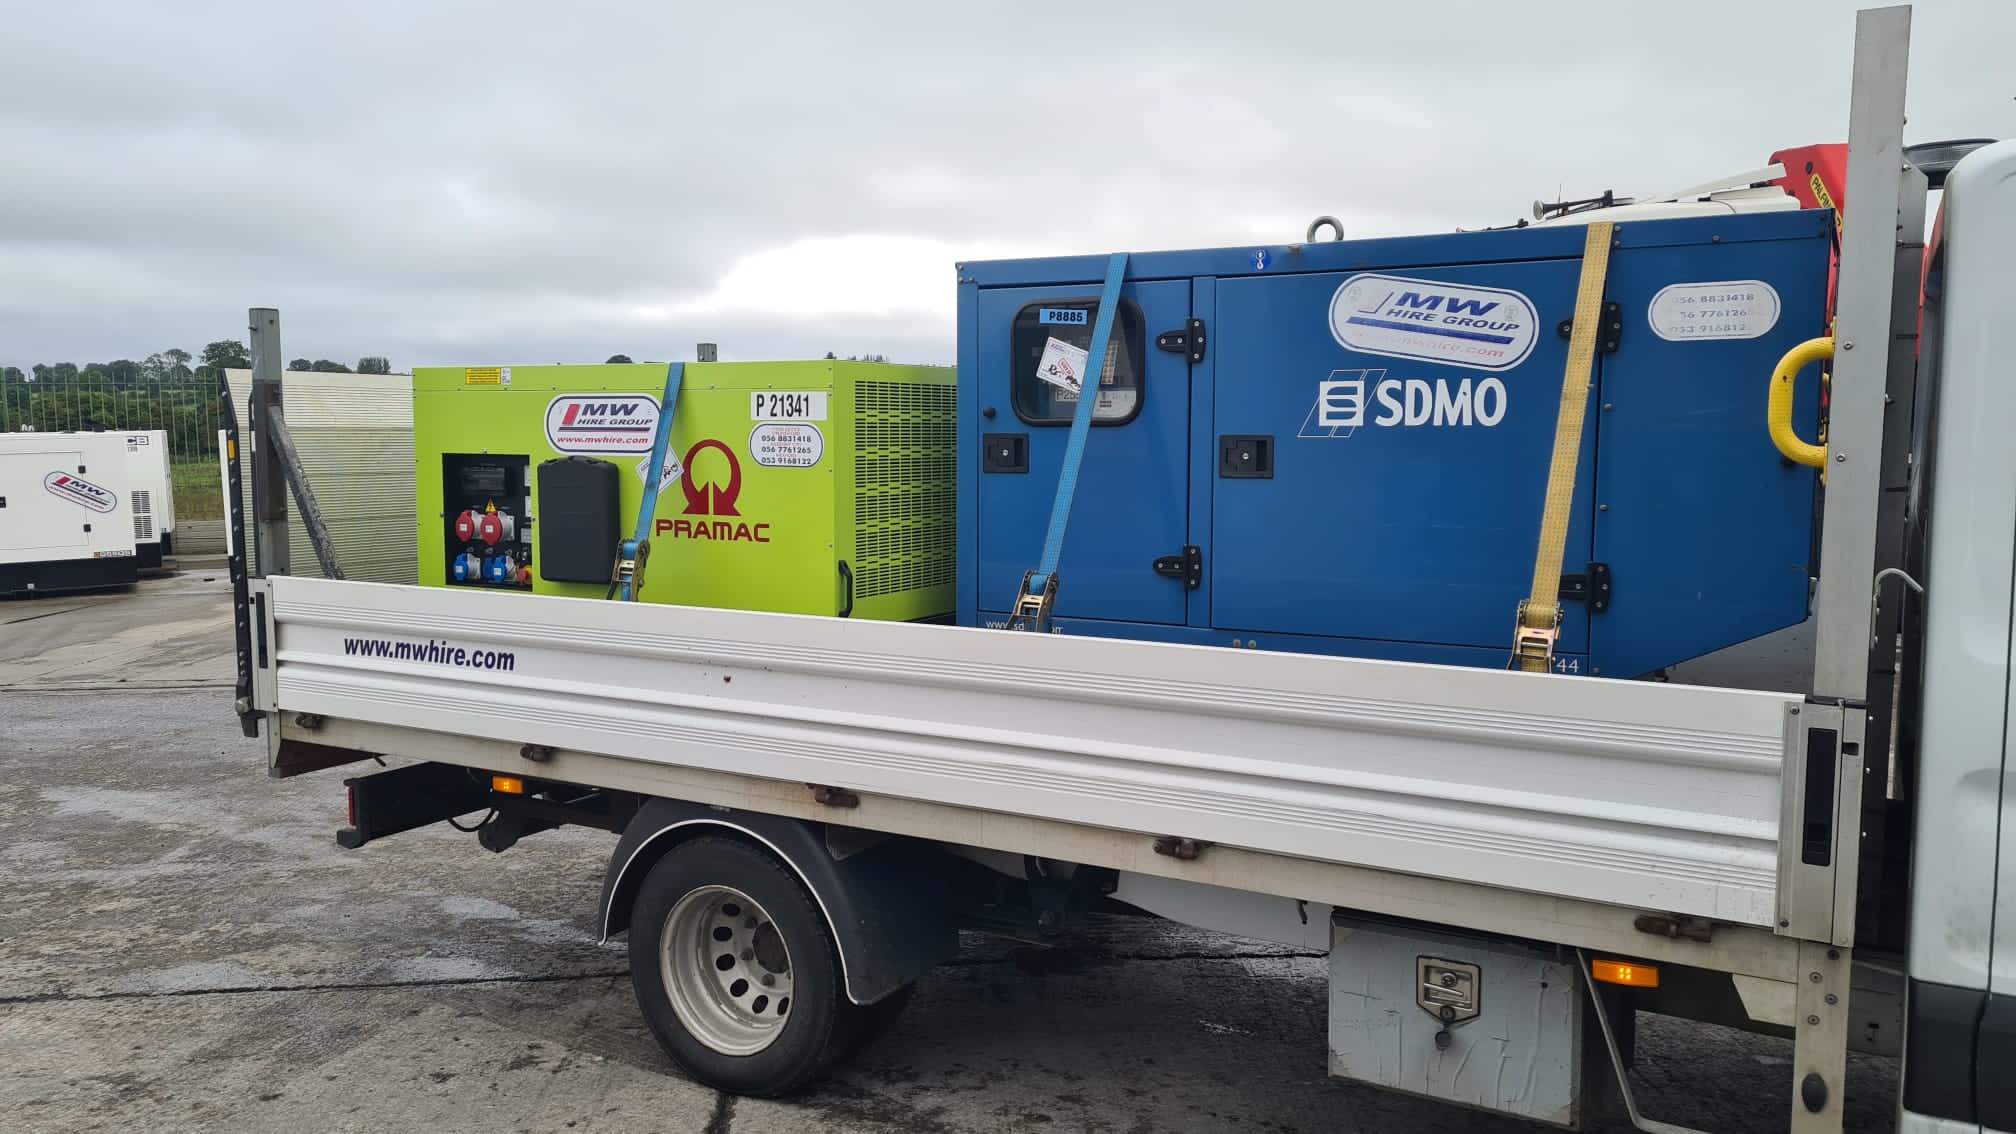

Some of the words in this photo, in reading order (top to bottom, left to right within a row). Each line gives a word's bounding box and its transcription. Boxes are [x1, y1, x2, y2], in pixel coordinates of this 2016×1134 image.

[1395, 291, 1500, 316] MW
[1386, 308, 1434, 321] HIRE
[1443, 315, 1520, 332] GROUP
[1700, 309, 1747, 318] 776126
[1700, 319, 1746, 332] 916812
[582, 403, 640, 416] MW
[756, 394, 765, 417] P
[770, 394, 809, 417] 21341
[1375, 377, 1508, 427] SDMO
[609, 418, 653, 426] GROUP
[557, 436, 649, 444] www.mwhire.com
[777, 446, 812, 454] 7761265
[70, 480, 106, 496] MW
[656, 519, 770, 543] PRAMAC
[344, 638, 515, 671] www.mwhire.com
